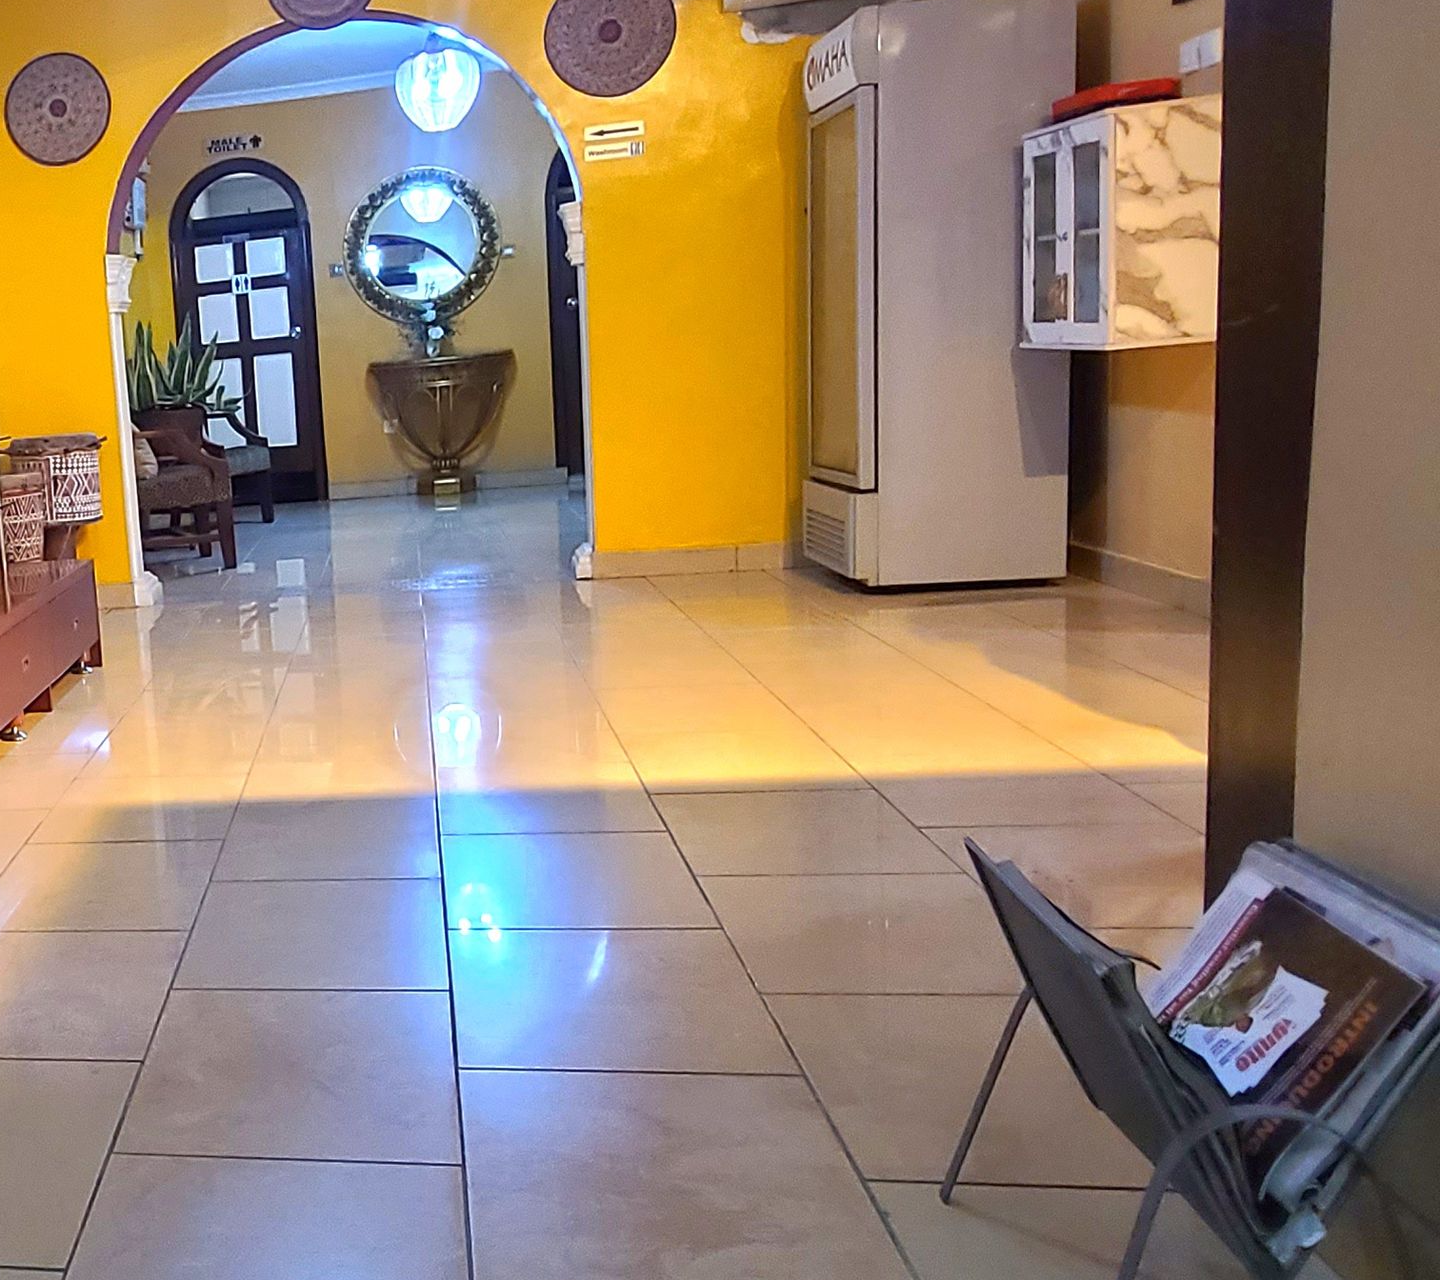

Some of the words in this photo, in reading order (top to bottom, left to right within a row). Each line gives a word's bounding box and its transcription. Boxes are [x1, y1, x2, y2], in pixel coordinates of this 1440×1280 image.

[806, 39, 849, 91] OMAHA
[207, 142, 247, 154] TOILET
[210, 137, 242, 147] MALE
